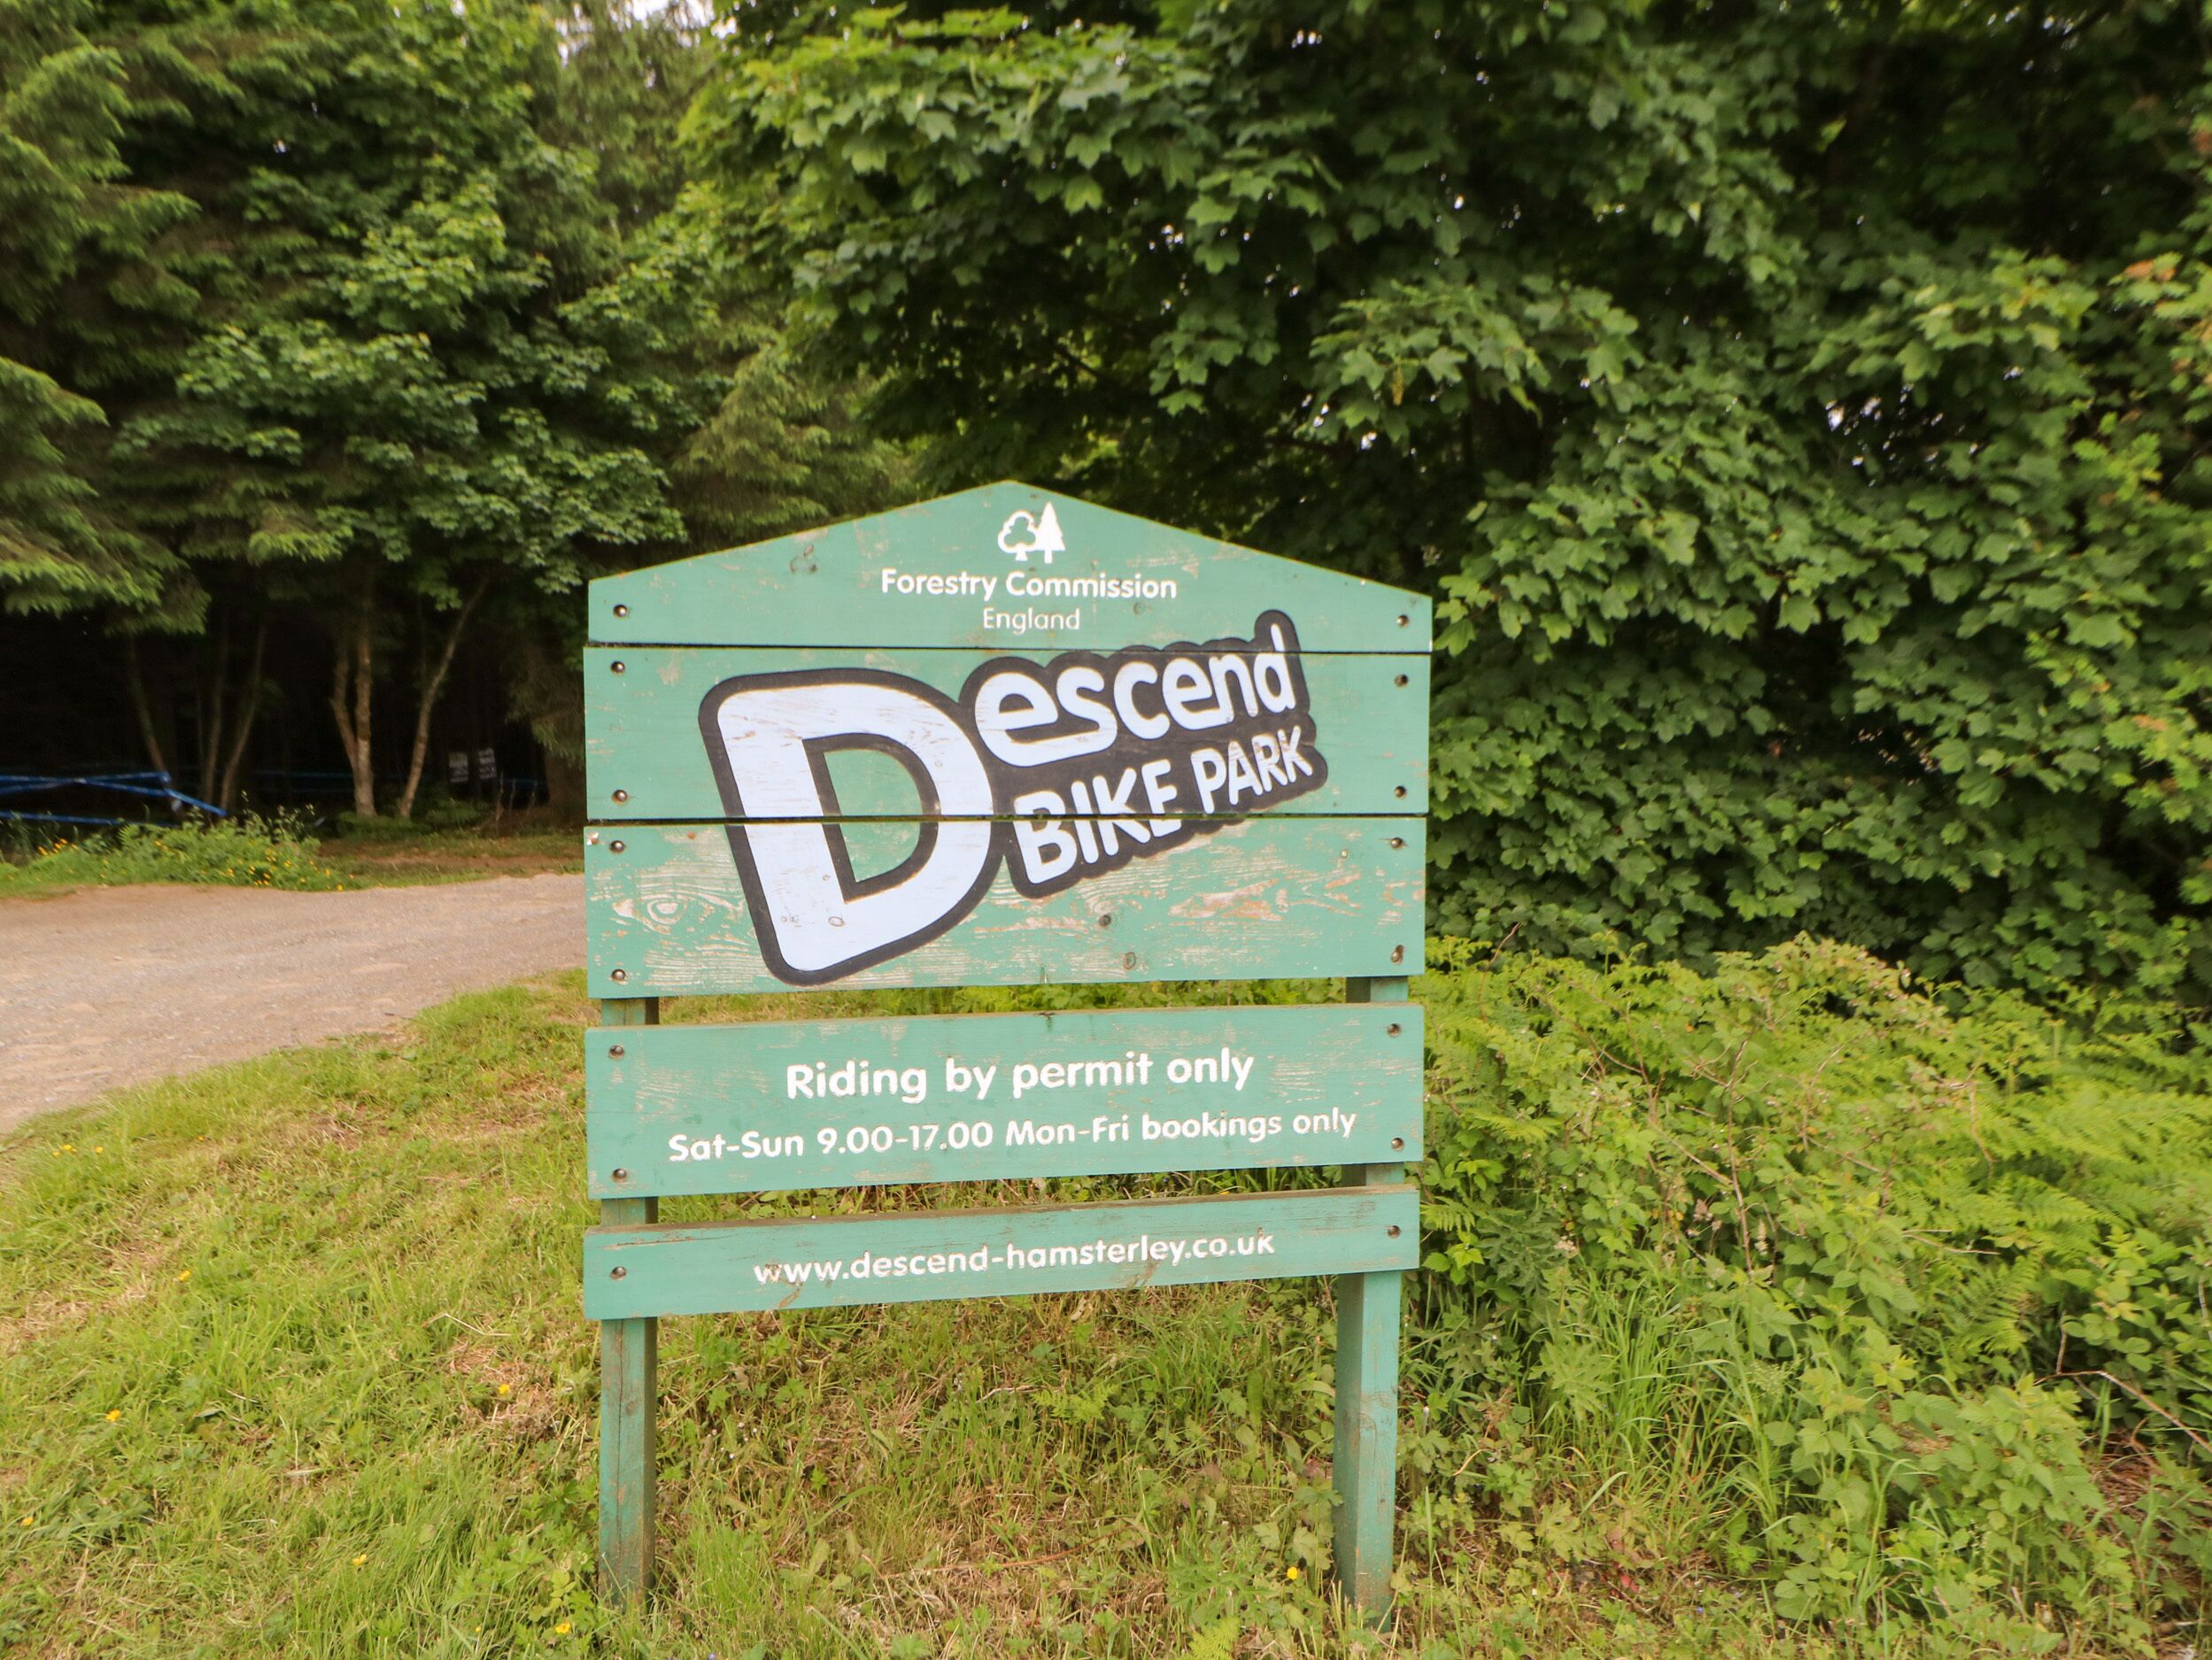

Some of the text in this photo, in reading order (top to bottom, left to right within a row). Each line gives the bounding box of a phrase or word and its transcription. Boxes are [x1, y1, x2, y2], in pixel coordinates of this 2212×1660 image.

[882, 568, 1177, 601] Forestry Commission
[983, 607, 1080, 635] England
[717, 623, 1296, 972] Descend
[1014, 726, 1312, 884] BIKE PARK
[786, 1047, 1255, 1104] Riding by permit only
[668, 1107, 1357, 1162] Sat-Sun 9.00-17.00 Mon-Fri bookings only
[754, 1234, 1275, 1285] www.descend-hamsterley.co.uk
